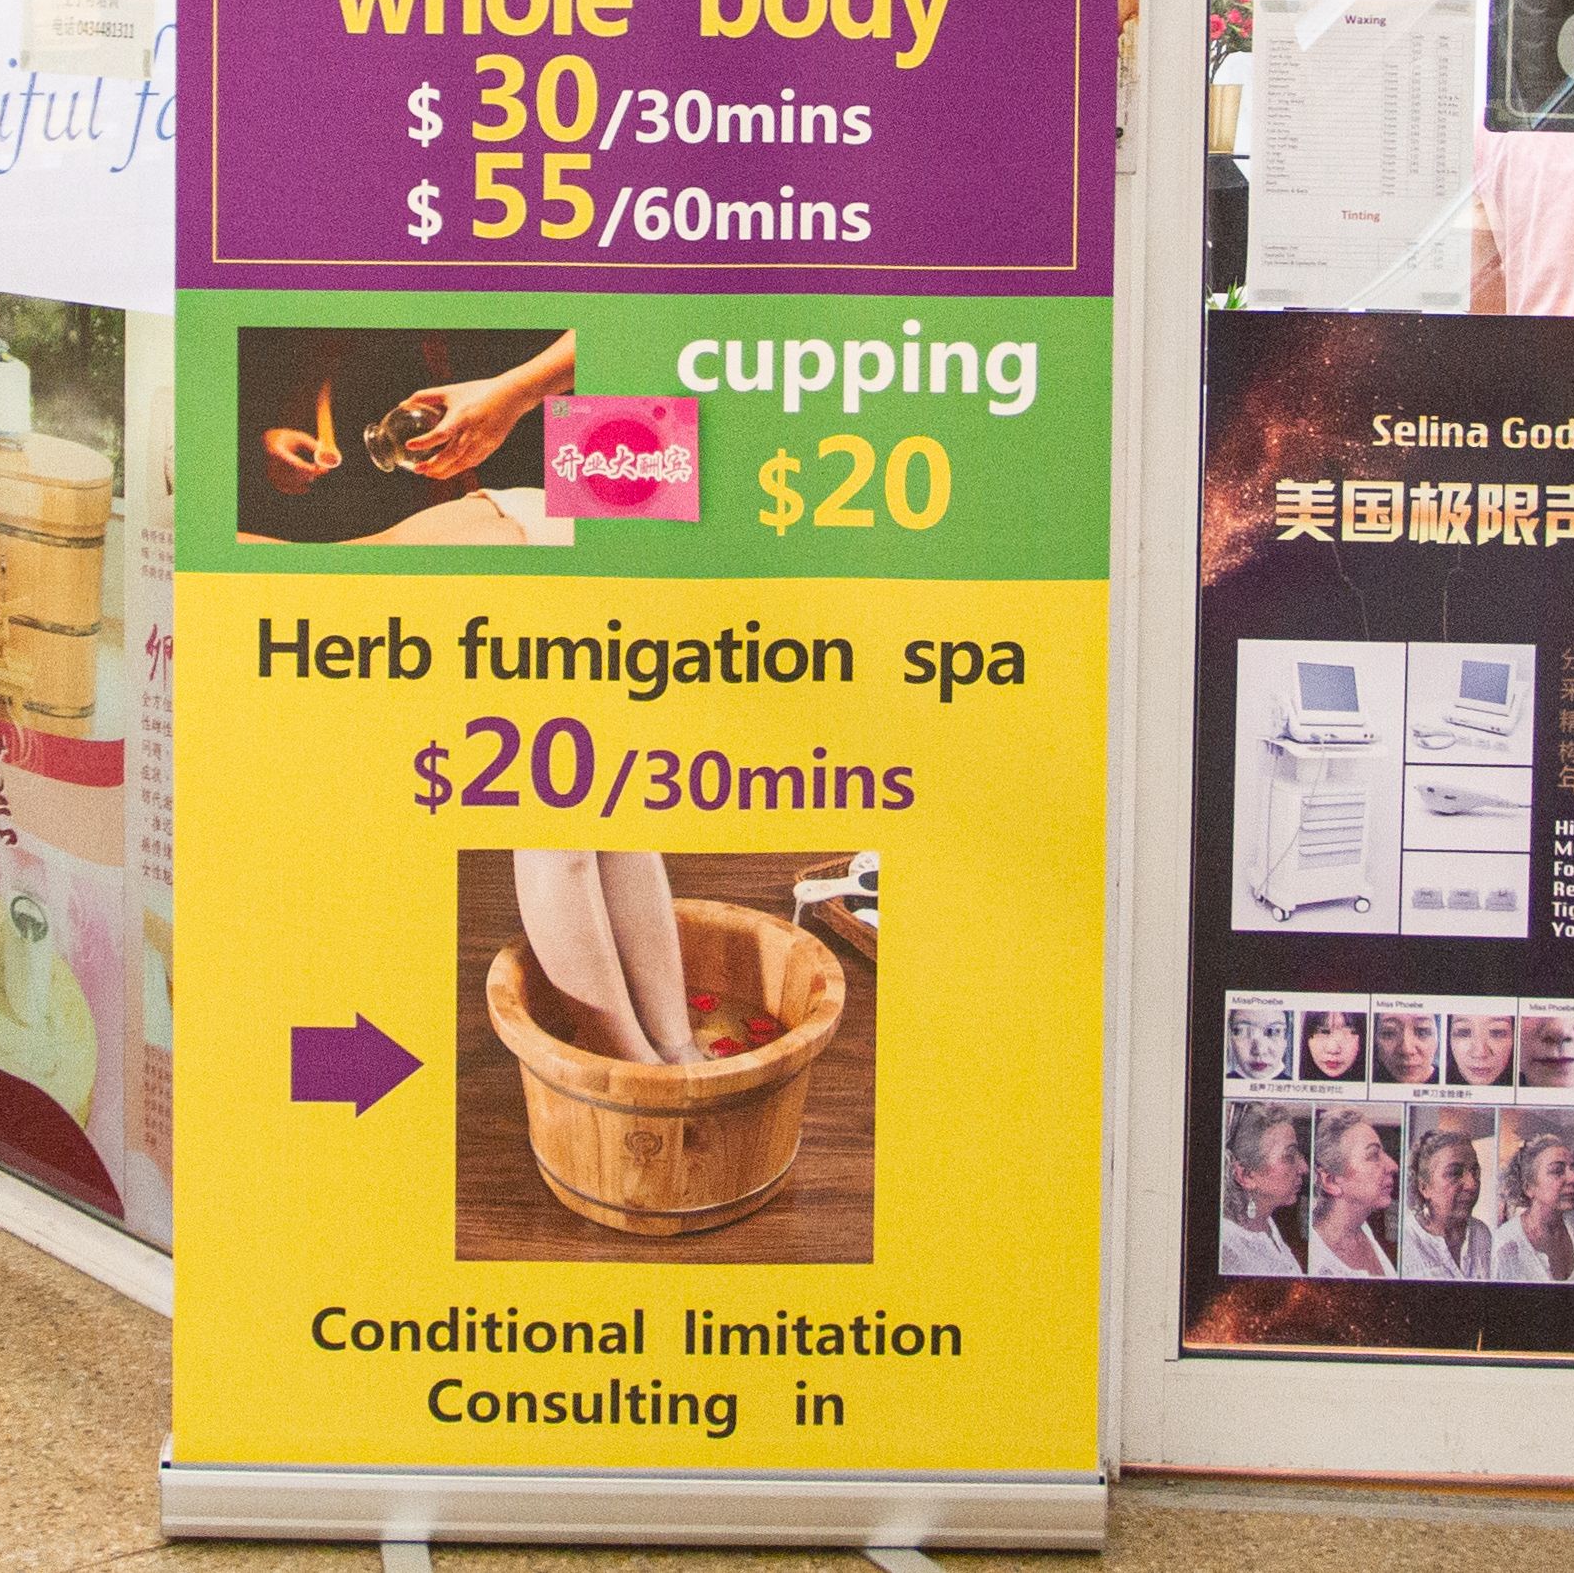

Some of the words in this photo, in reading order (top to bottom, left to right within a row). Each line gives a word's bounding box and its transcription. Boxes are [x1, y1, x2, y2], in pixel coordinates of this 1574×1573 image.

[1344, 13, 1387, 28] Waxing
[407, 81, 443, 145] $
[407, 178, 443, 244] $
[1341, 209, 1381, 223] Tinting
[676, 320, 1039, 417] cupping
[1372, 414, 1488, 449] Selina
[551, 443, 693, 483] 开业大酬宾
[758, 435, 952, 538] $20
[258, 618, 431, 680] Herb
[458, 619, 855, 702] fumigation
[903, 634, 1027, 703] spa
[412, 716, 916, 818] $20/30mins
[311, 1306, 645, 1355] Conditional
[684, 1308, 962, 1357] limitation
[427, 1380, 739, 1439] Consulting
[796, 1381, 845, 1426] in
